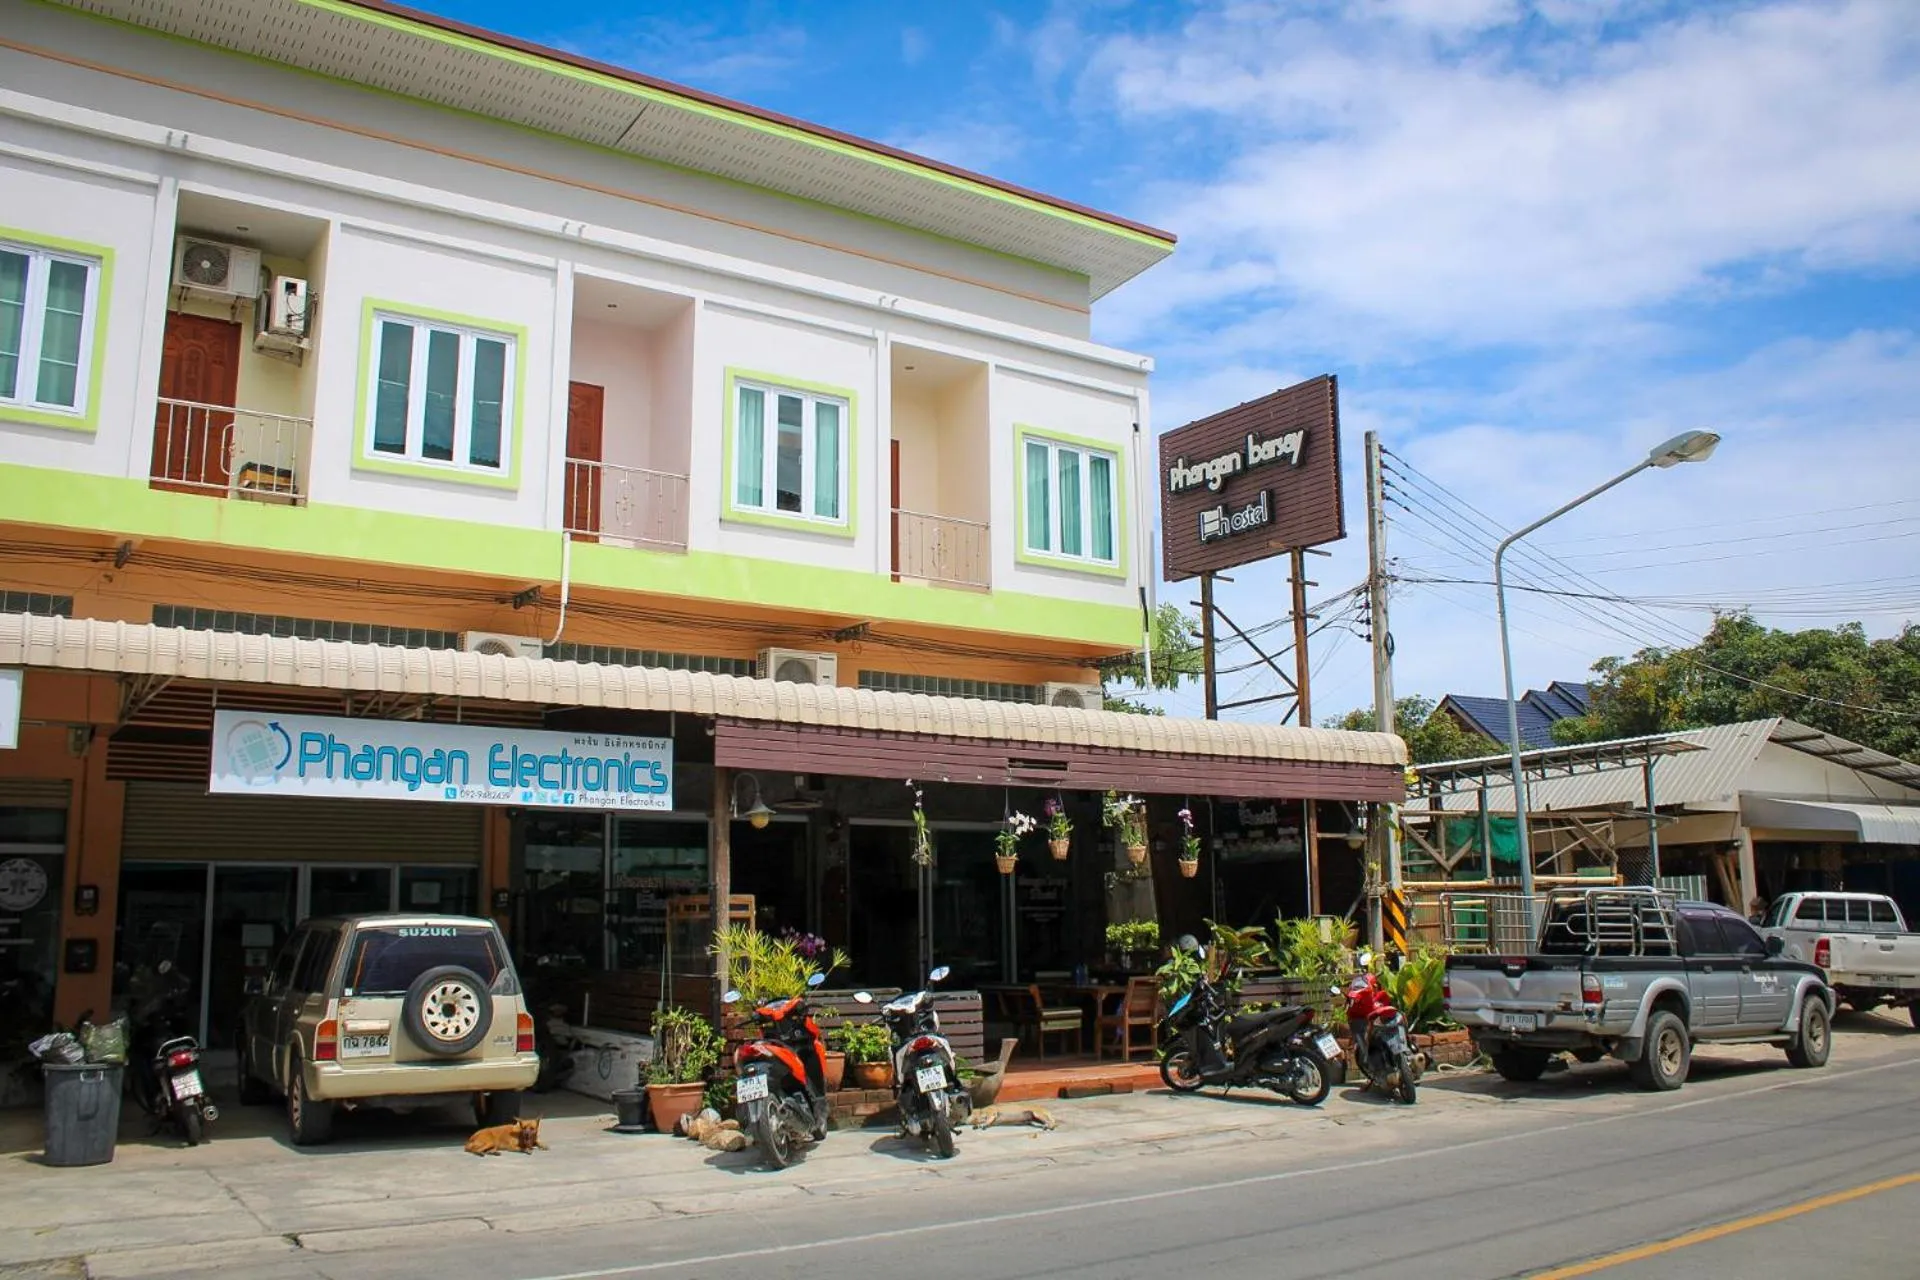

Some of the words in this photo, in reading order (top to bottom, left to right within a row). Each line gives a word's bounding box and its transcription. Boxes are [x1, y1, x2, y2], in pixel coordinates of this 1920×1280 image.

[1216, 490, 1268, 536] hostel
[298, 732, 469, 791] Phangan
[488, 743, 669, 795] Electronics
[578, 794, 617, 806] Phangan
[620, 795, 666, 808] Electronics
[398, 927, 457, 937] SUZUKI
[363, 1035, 389, 1048] 7842
